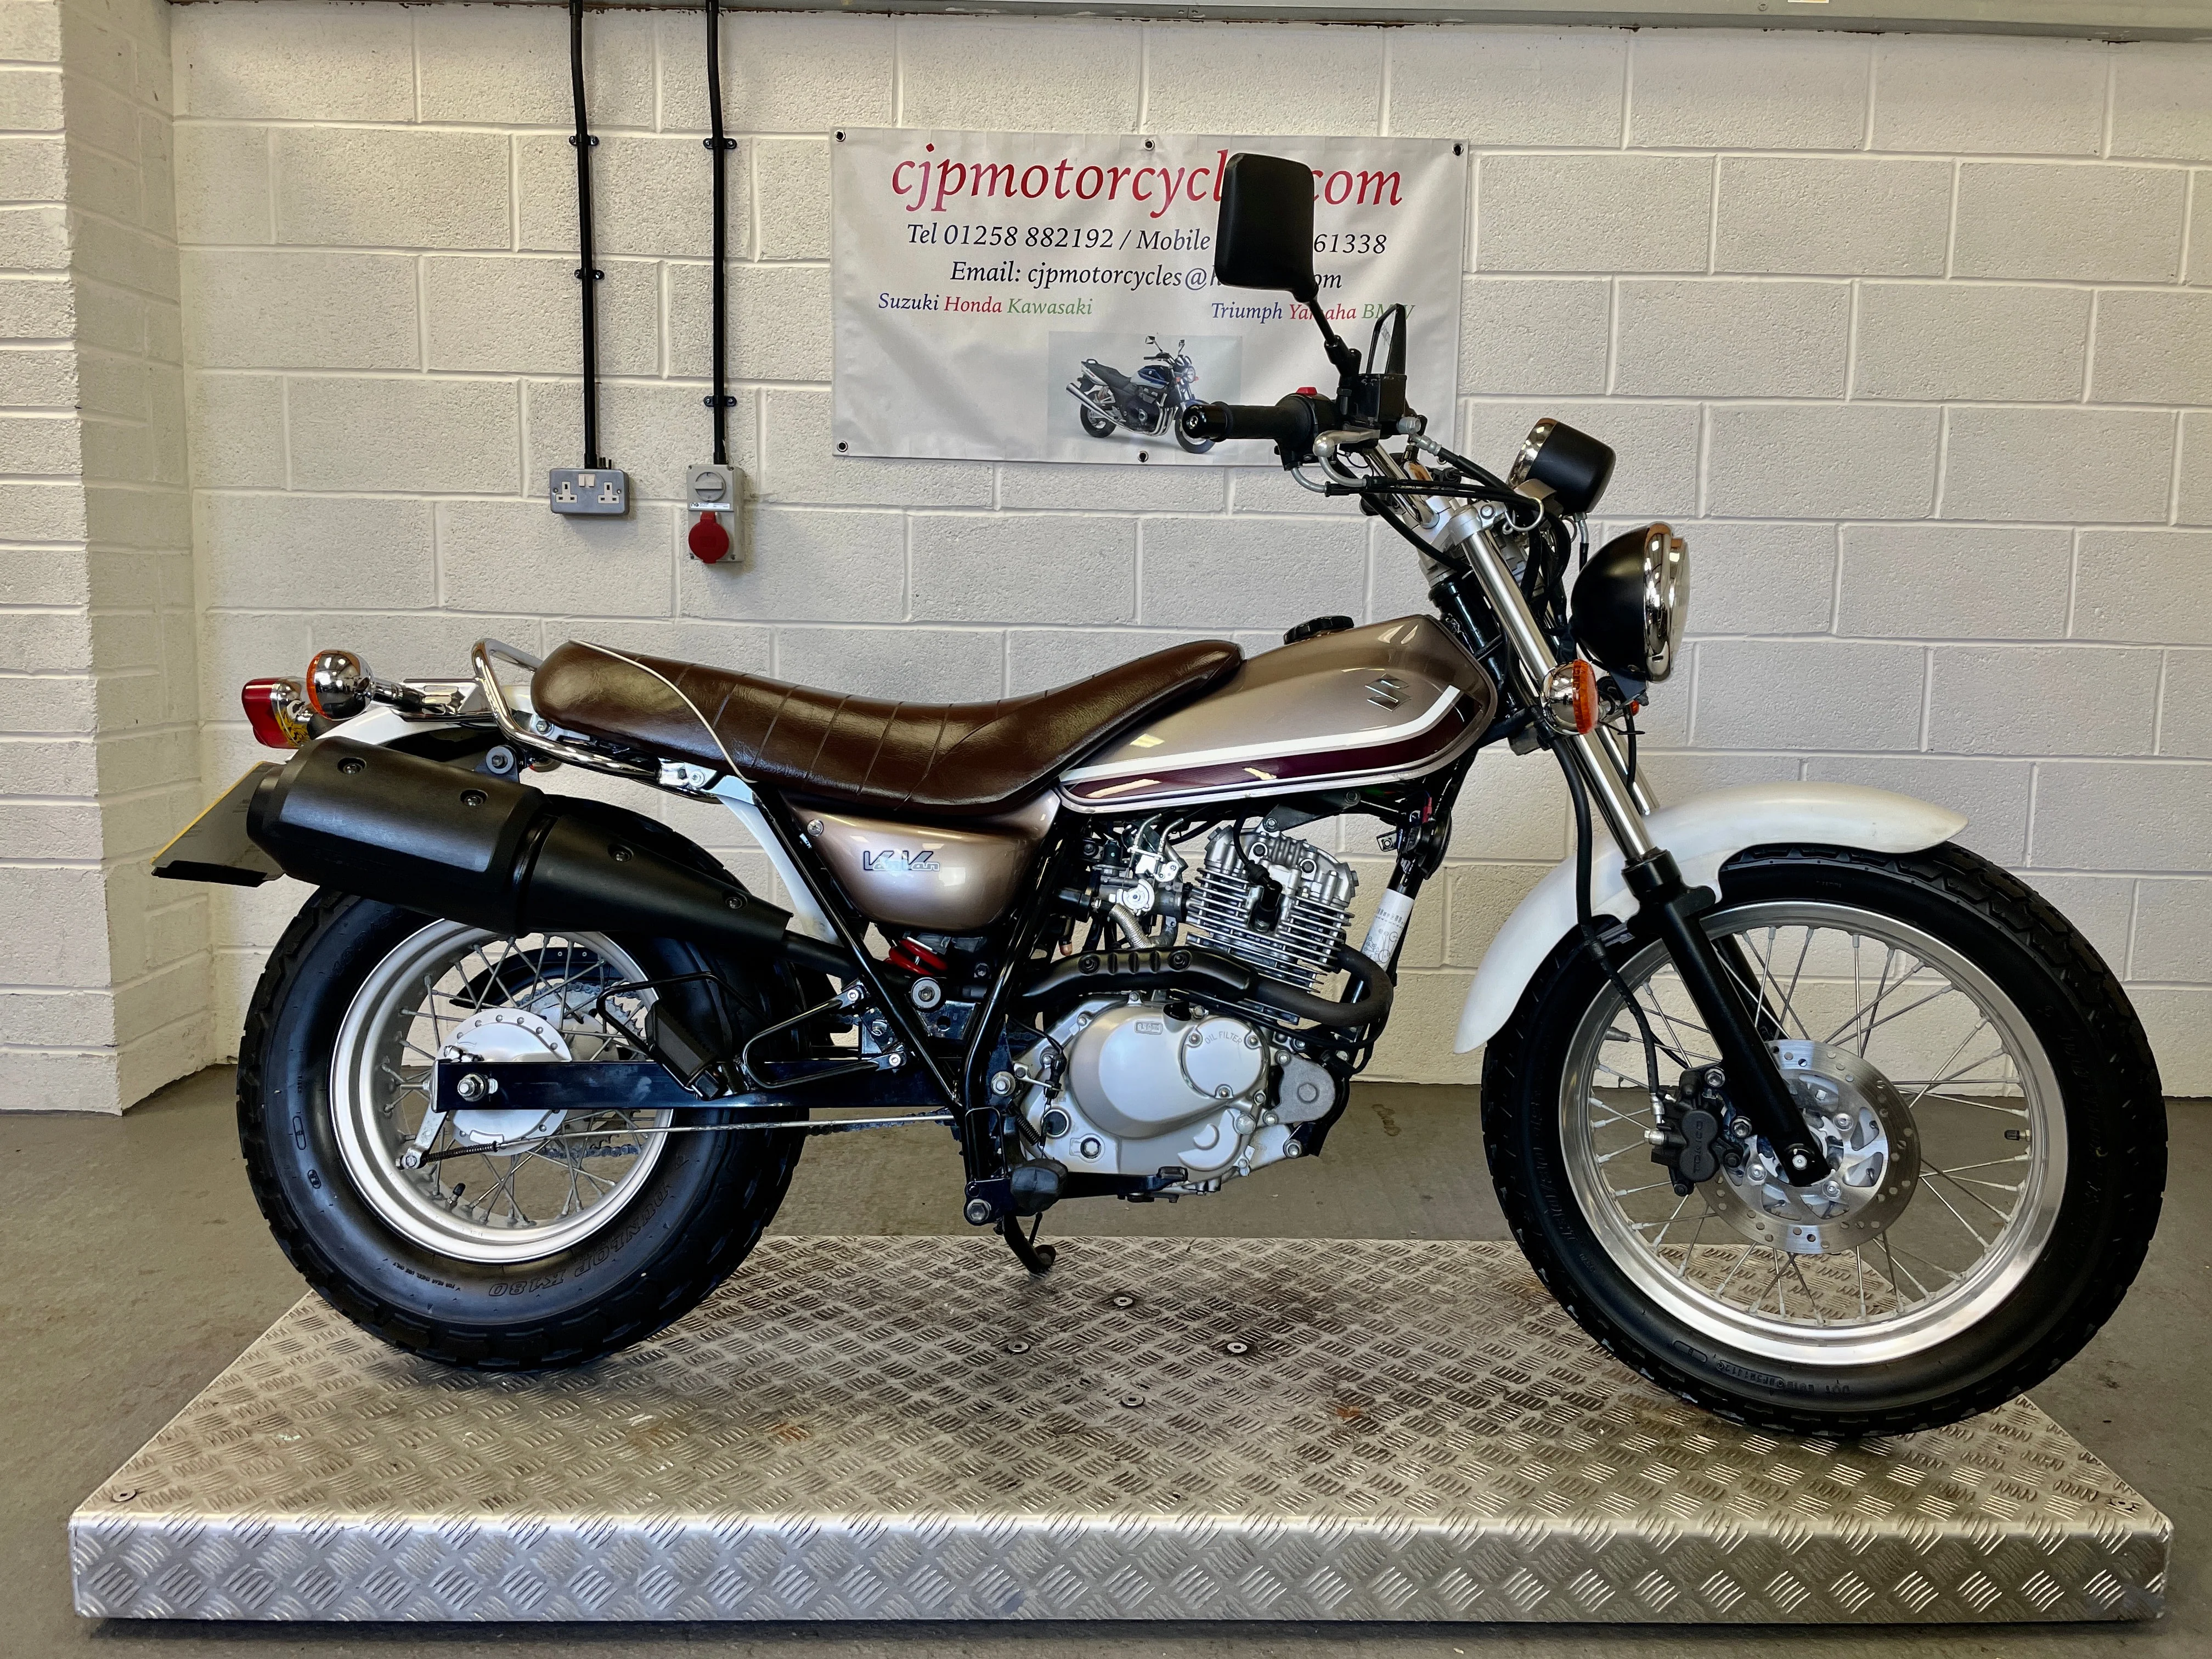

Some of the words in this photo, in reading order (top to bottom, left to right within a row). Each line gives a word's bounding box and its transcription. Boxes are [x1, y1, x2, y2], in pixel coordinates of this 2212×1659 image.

[891, 143, 1403, 218] cjpmotorcyclom
[907, 222, 938, 245] Tel
[944, 224, 1018, 246] 01258
[1025, 227, 1114, 249] 882192
[1136, 228, 1210, 251] Mobile
[1314, 233, 1387, 254] 61338
[950, 260, 1021, 283] Email:
[879, 292, 940, 312] Suzuki
[944, 295, 1002, 314] Honda
[1007, 297, 1093, 315] Kawasaki
[1211, 301, 1283, 324] Triumph
[1204, 1034, 1218, 1045] OIL
[1218, 1030, 1243, 1045] FILTER
[1693, 1120, 1704, 1173] TOKICO
[574, 1181, 672, 1277] DUNLOP
[488, 1268, 566, 1297] K180
